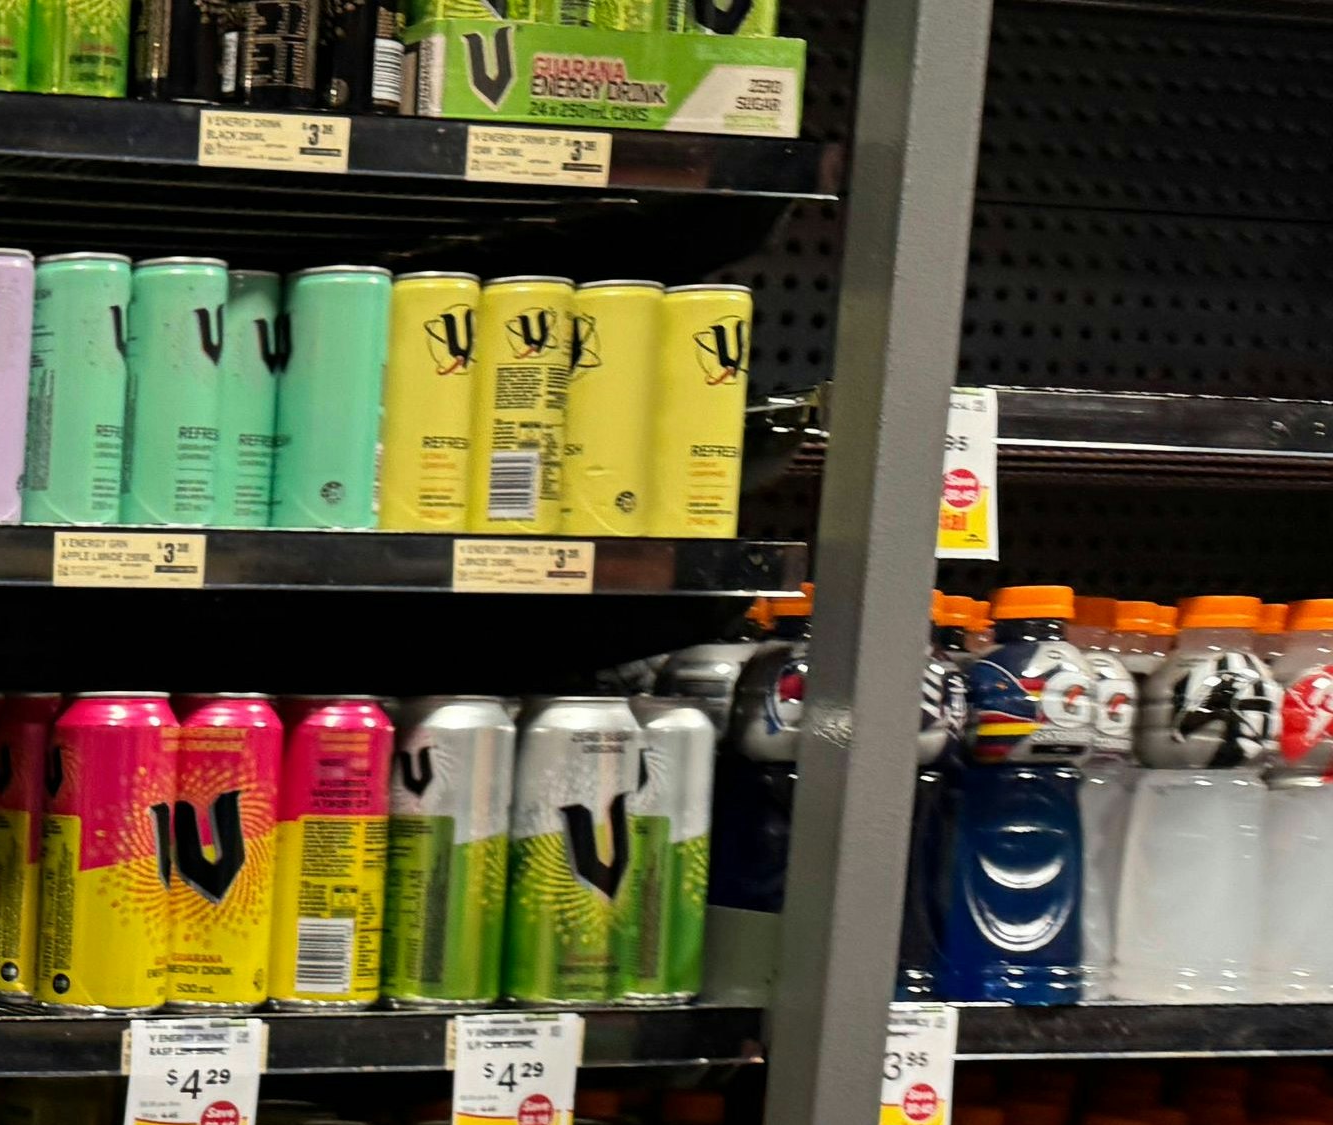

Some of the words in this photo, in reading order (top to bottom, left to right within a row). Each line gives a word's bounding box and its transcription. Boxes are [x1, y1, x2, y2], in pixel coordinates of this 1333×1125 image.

[535, 56, 626, 78] GUARANA
[531, 77, 605, 98] ENERGY
[607, 81, 668, 103] DRINK
[735, 96, 781, 112] SUGAR
